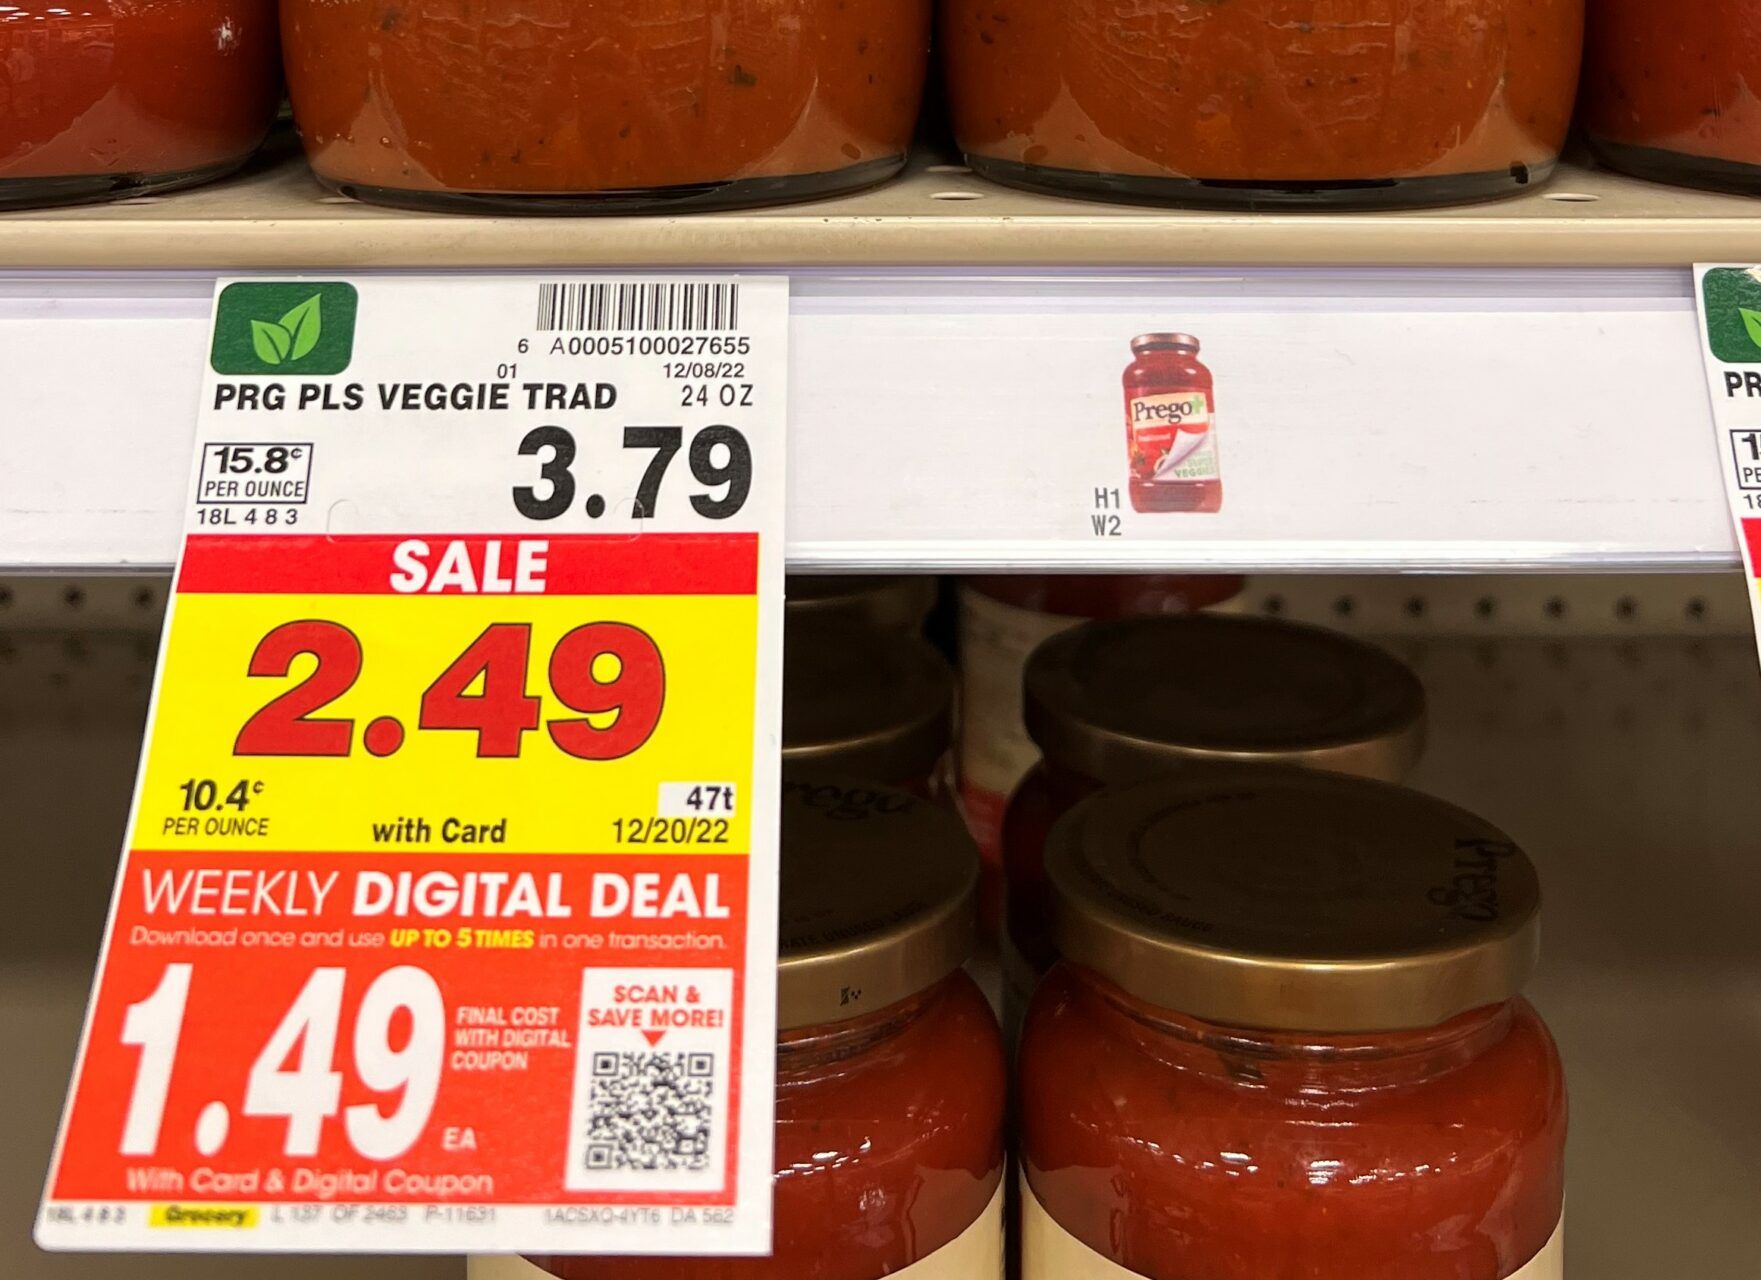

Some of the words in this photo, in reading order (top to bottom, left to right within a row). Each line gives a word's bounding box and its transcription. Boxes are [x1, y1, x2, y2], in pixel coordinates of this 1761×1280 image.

[517, 338, 529, 354] 6
[550, 336, 750, 356] A0005100027655
[497, 363, 517, 379] 01
[663, 362, 745, 379] 12/08/22
[1723, 371, 1761, 397] PR
[213, 384, 286, 411] PRG
[298, 383, 364, 411] PLS
[377, 383, 510, 411] VEGGIE
[522, 382, 618, 410] TRAD
[680, 384, 709, 407] 24
[719, 384, 754, 407] OZ
[1134, 401, 1193, 424] Prego
[511, 424, 753, 521] 3.79
[205, 481, 240, 498] PER
[245, 480, 306, 498] OUNCE
[1094, 488, 1121, 509] H1
[197, 508, 237, 525] 18L
[244, 508, 257, 525] 4
[265, 508, 278, 525] 8
[285, 508, 298, 525] 3
[1091, 515, 1122, 536] W2
[389, 539, 549, 594] SALE
[232, 618, 666, 761] 2.49
[686, 786, 735, 811] 47t
[162, 818, 201, 837] PER
[204, 818, 270, 837] OUNCE
[372, 819, 432, 844] with
[441, 818, 507, 844] Card
[613, 818, 729, 844] 12/20/22
[141, 869, 340, 916] WEEKLY
[352, 871, 572, 918] DIGITAL
[588, 872, 730, 918] DEAL
[130, 927, 238, 949] Download
[242, 932, 295, 949] once
[299, 928, 344, 949] and
[347, 932, 384, 949] use
[391, 929, 417, 949] UP
[420, 929, 452, 949] TO
[458, 929, 473, 949] 5
[474, 929, 534, 949] TIMES
[540, 930, 558, 948] in
[562, 933, 603, 949] one
[607, 930, 728, 949] transaction.
[613, 985, 677, 1004] SCAN
[684, 985, 702, 1004] &
[457, 1007, 505, 1025] FINAL
[508, 1007, 559, 1025] COST
[588, 1009, 643, 1028] SAVE
[651, 1009, 725, 1028] MORE!
[455, 1029, 501, 1048] WITH
[505, 1029, 572, 1048] DIGITAL
[118, 962, 446, 1161] 1.49
[451, 1051, 528, 1070] COUPON
[442, 1129, 477, 1151] EA
[126, 1170, 186, 1193] With
[191, 1169, 262, 1193] Card
[266, 1170, 286, 1193] &
[292, 1169, 378, 1199] Digital
[384, 1170, 494, 1200] Coupon
[166, 1205, 250, 1228] Grocery
